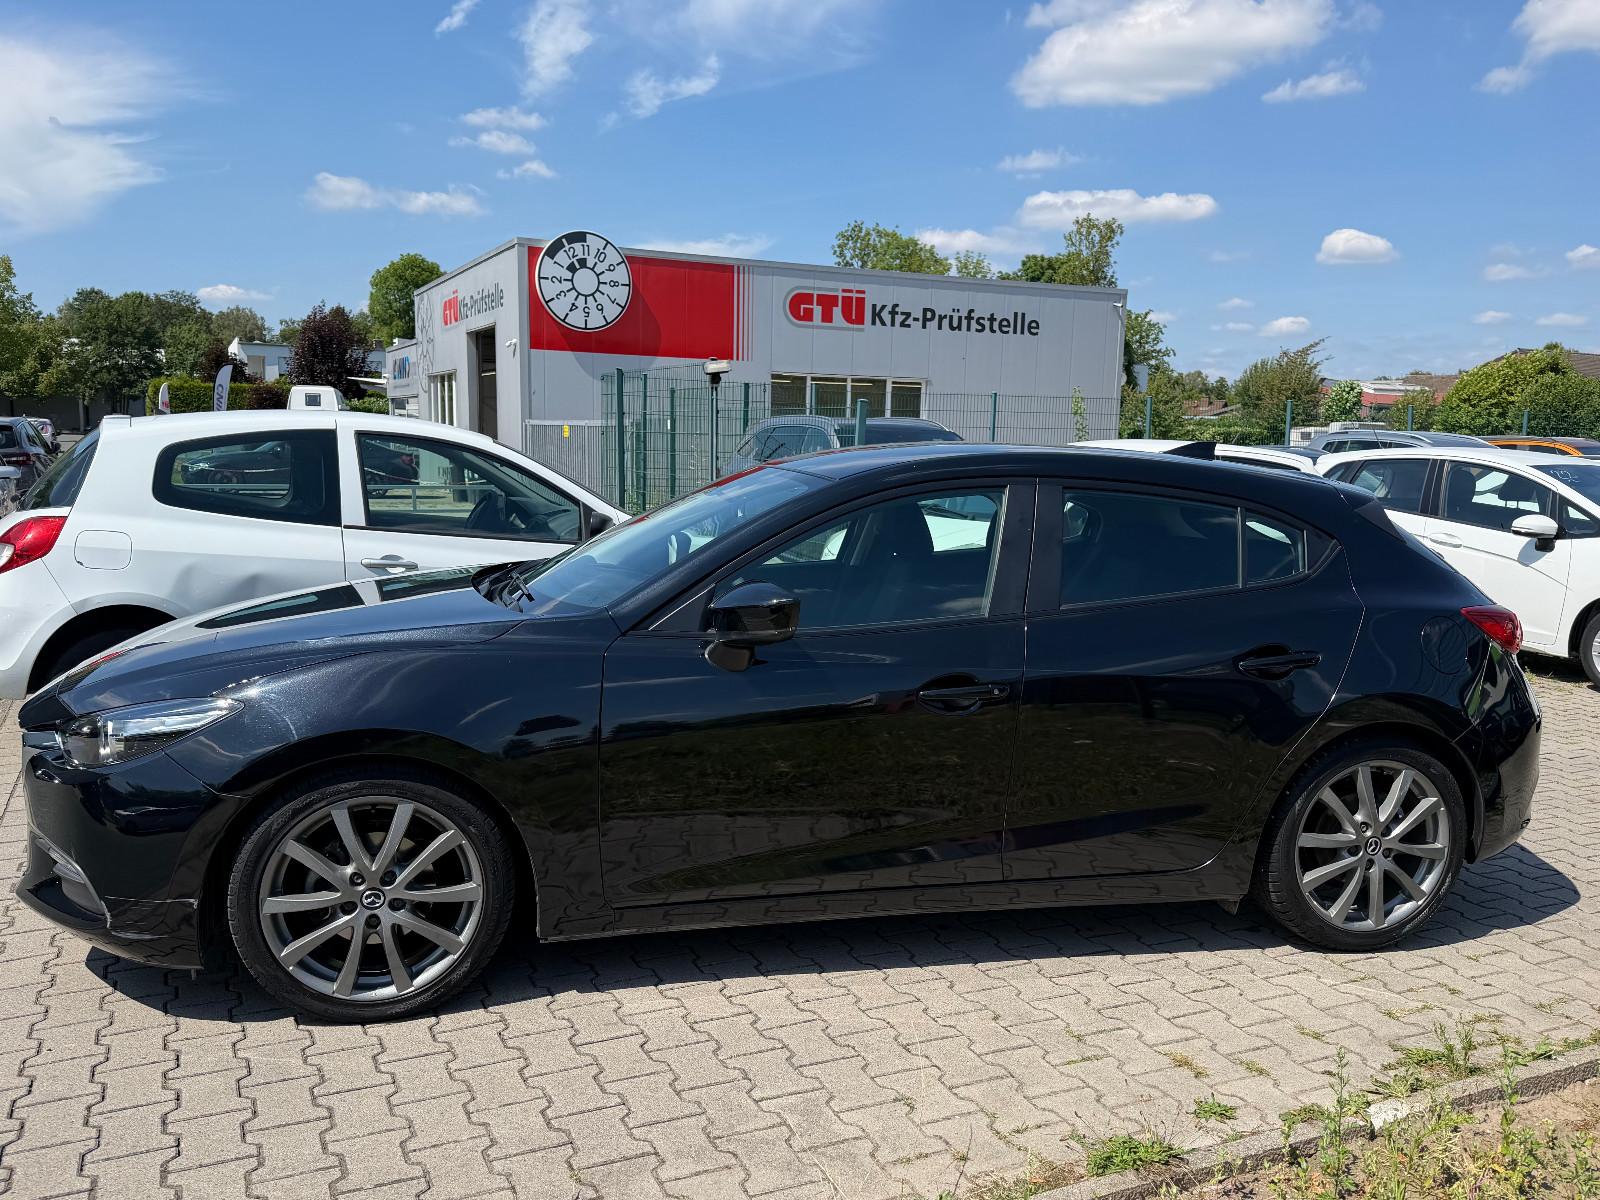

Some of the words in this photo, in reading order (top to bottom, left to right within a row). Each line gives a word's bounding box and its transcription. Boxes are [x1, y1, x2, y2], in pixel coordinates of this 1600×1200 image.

[564, 246, 578, 260] 12
[581, 244, 590, 257] 11
[594, 248, 606, 263] 10
[553, 260, 564, 269] 1
[605, 264, 616, 272] 9
[550, 276, 562, 284] 2
[609, 280, 619, 288] 8
[556, 290, 566, 300] 3
[606, 294, 616, 304] 7
[443, 289, 459, 326] GTÜ
[459, 282, 504, 322] Kfz-Prüfstelle
[569, 302, 578, 312] 4
[596, 303, 604, 315] 6
[583, 306, 590, 318] 5
[788, 288, 866, 326] GTÜ
[871, 303, 1040, 336] Kfz-Prüfstelle
